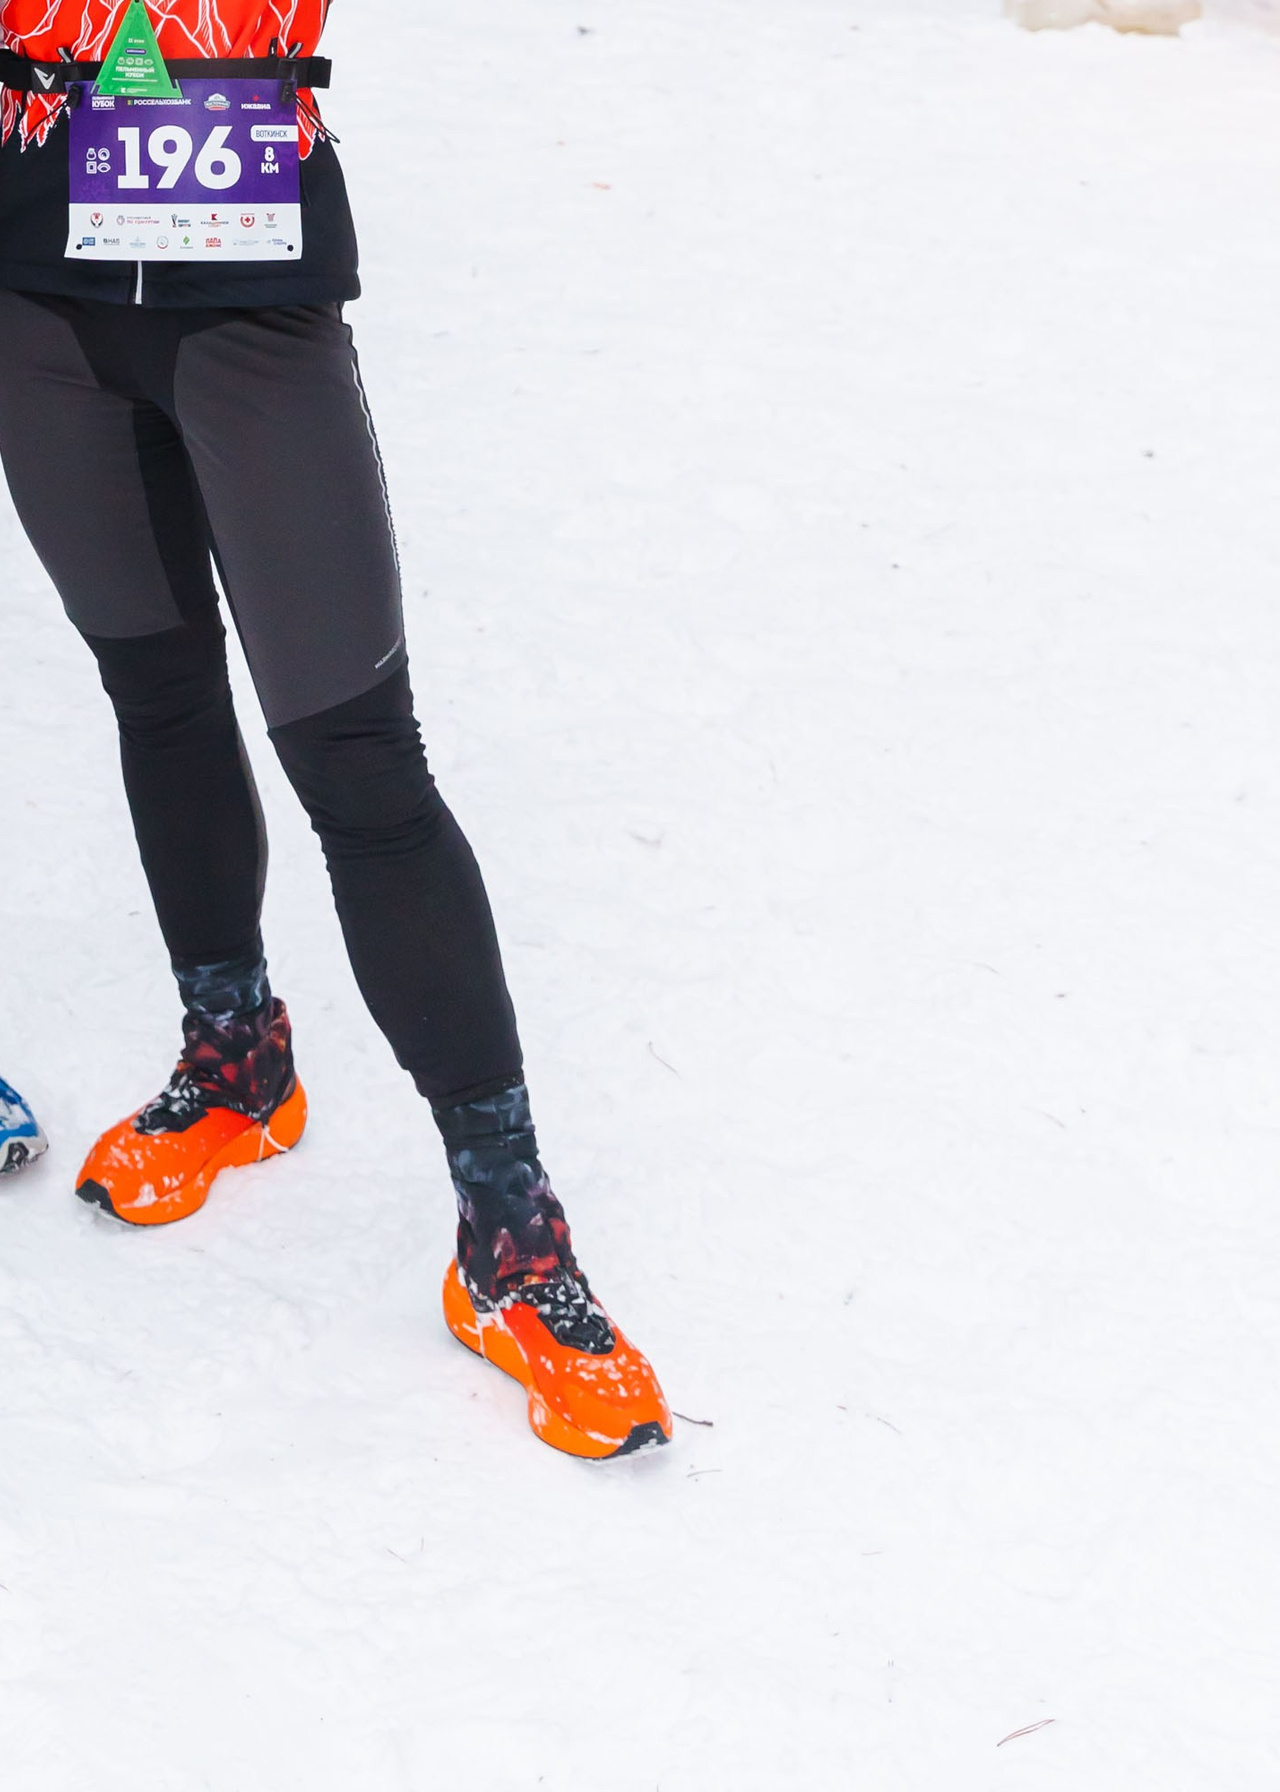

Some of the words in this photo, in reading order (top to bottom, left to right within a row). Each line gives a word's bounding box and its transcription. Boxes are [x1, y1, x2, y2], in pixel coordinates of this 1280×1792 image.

[92, 99, 115, 108] КУБОК
[255, 129, 288, 138] ВОТКИНСК
[117, 125, 242, 190] 196
[264, 146, 275, 162] 8
[261, 162, 280, 173] КМ
